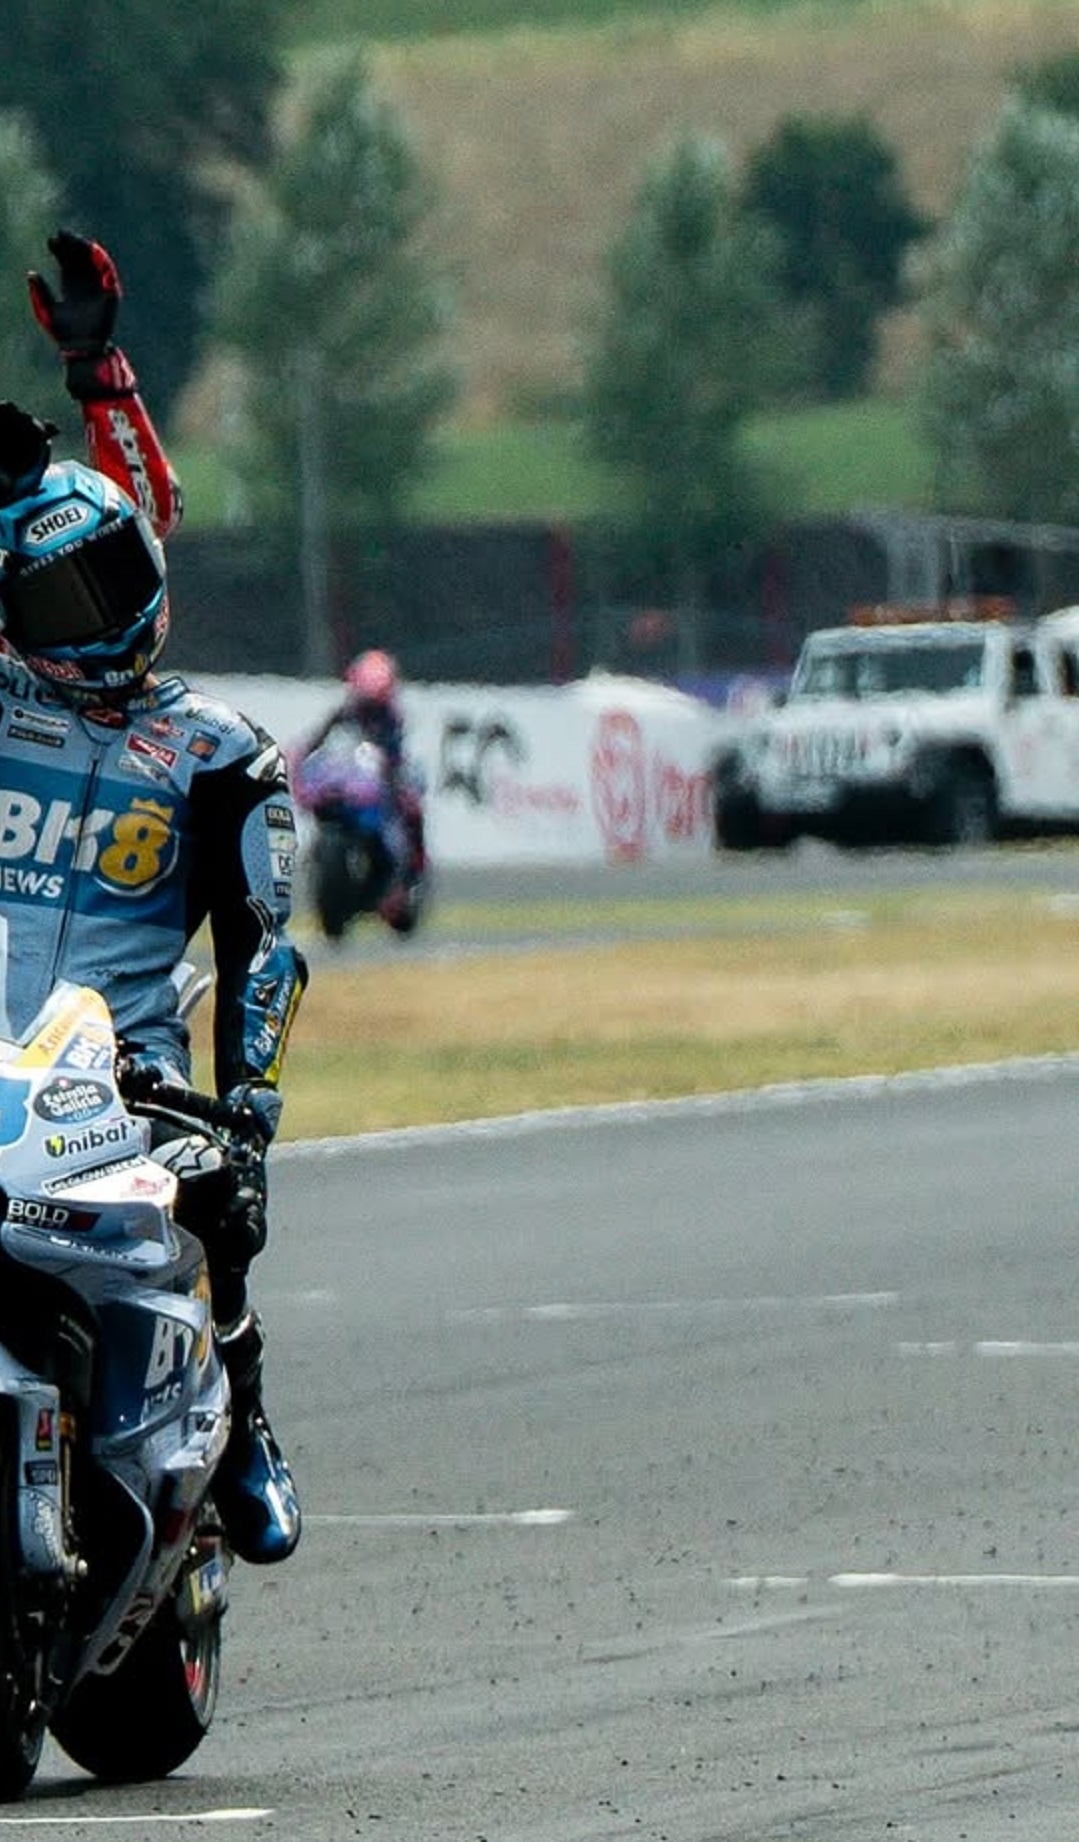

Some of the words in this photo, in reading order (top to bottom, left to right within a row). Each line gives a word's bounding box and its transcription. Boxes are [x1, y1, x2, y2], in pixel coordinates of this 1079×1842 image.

[30, 507, 83, 541] SHOEI
[45, 1122, 128, 1158] Unibat
[8, 1199, 70, 1224] BOLD
